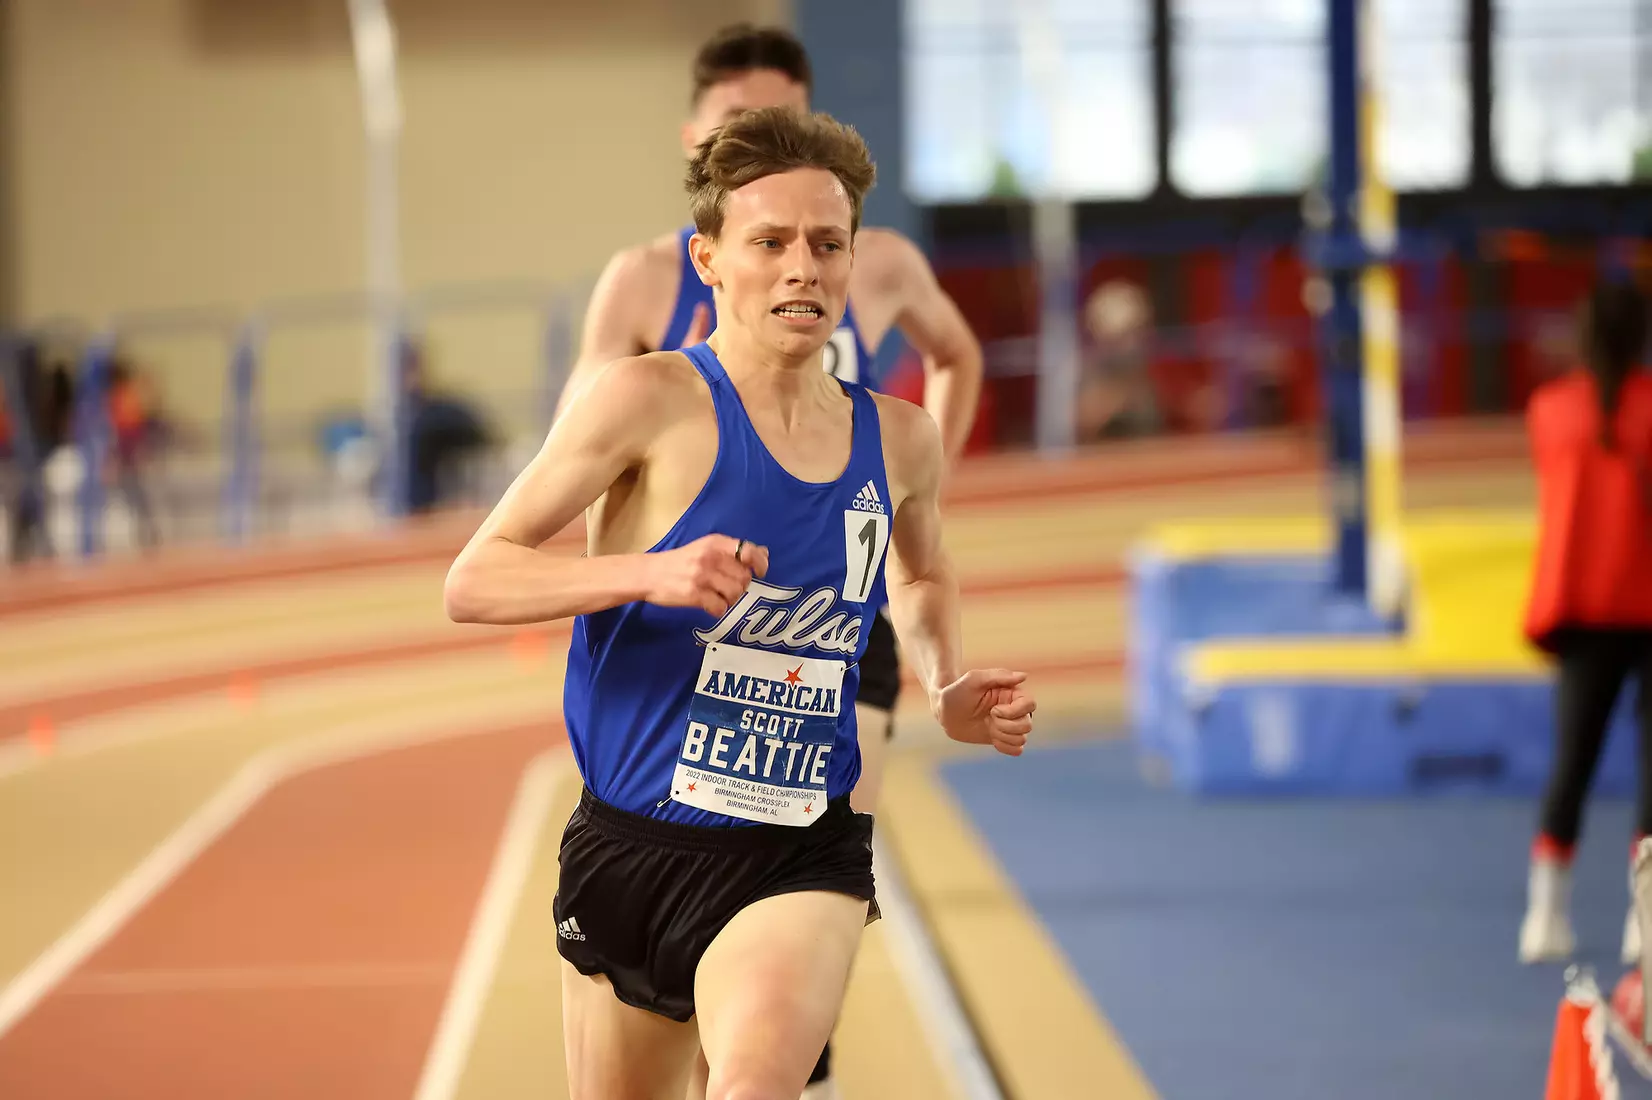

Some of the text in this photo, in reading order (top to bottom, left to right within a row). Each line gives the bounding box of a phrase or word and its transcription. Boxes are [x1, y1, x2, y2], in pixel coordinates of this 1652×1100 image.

[852, 496, 885, 514] adidas
[857, 518, 877, 597] 1
[692, 577, 862, 656] Tulsa
[703, 670, 837, 713] AMERICAN
[739, 709, 804, 738] SCOTT
[681, 720, 832, 785] BEATTIE
[685, 769, 817, 801] 2022 INDOOR TRACK & FIELD CHAMPIONSHIPS
[714, 787, 790, 808] BIRMINGHAM CROSSPLEX
[726, 799, 778, 816] BIRMINGHAM, AL
